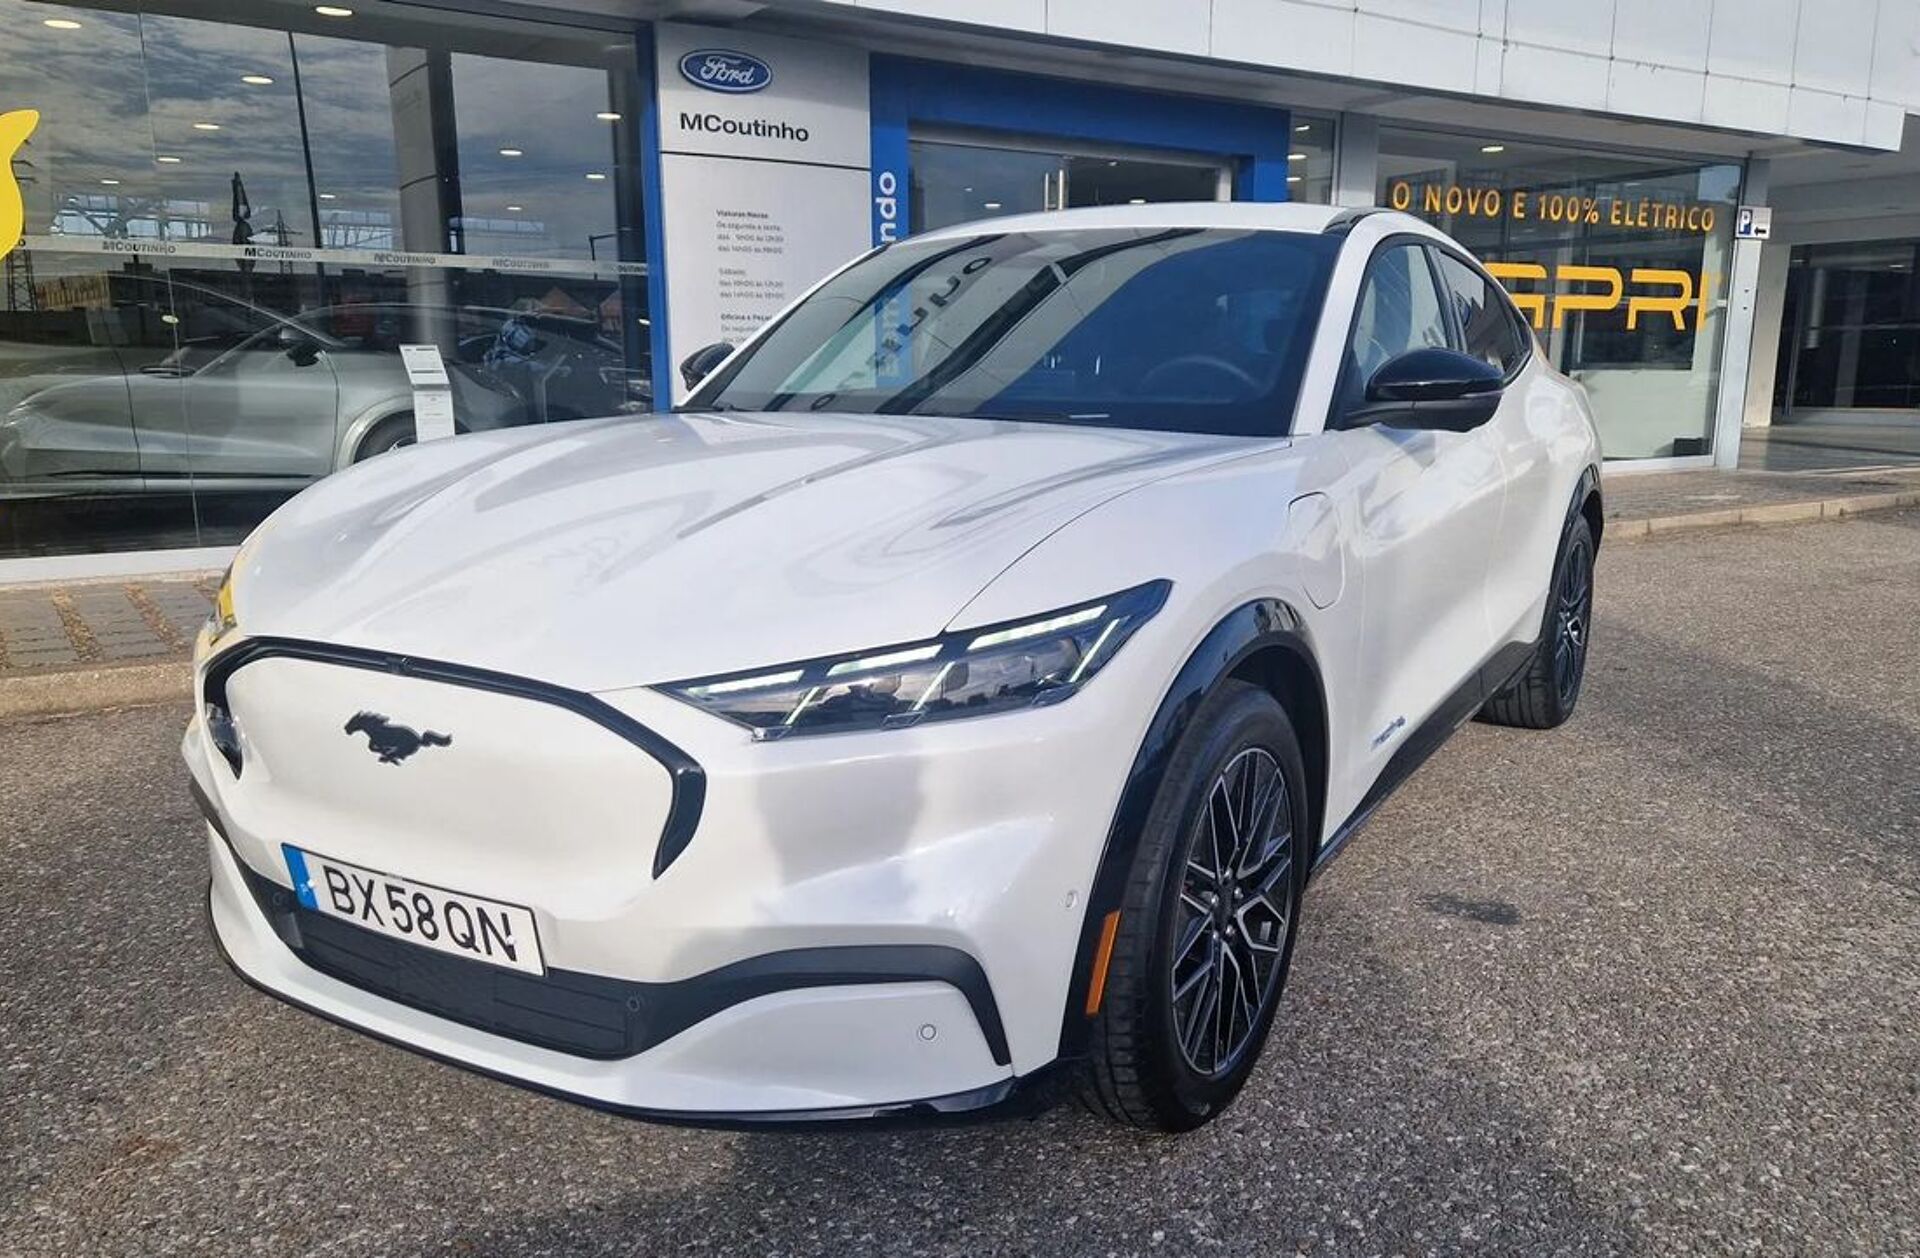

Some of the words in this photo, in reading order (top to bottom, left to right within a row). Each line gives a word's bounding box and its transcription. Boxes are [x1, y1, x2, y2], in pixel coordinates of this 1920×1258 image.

[700, 55, 755, 84] Ford
[680, 112, 809, 142] MCoutinho
[1392, 181, 1411, 210] O
[1424, 185, 1501, 219] NOVO
[1513, 192, 1527, 219] E
[1538, 195, 1599, 224] 100%
[1610, 198, 1715, 232] ELÉTRICO
[1740, 209, 1752, 234] P
